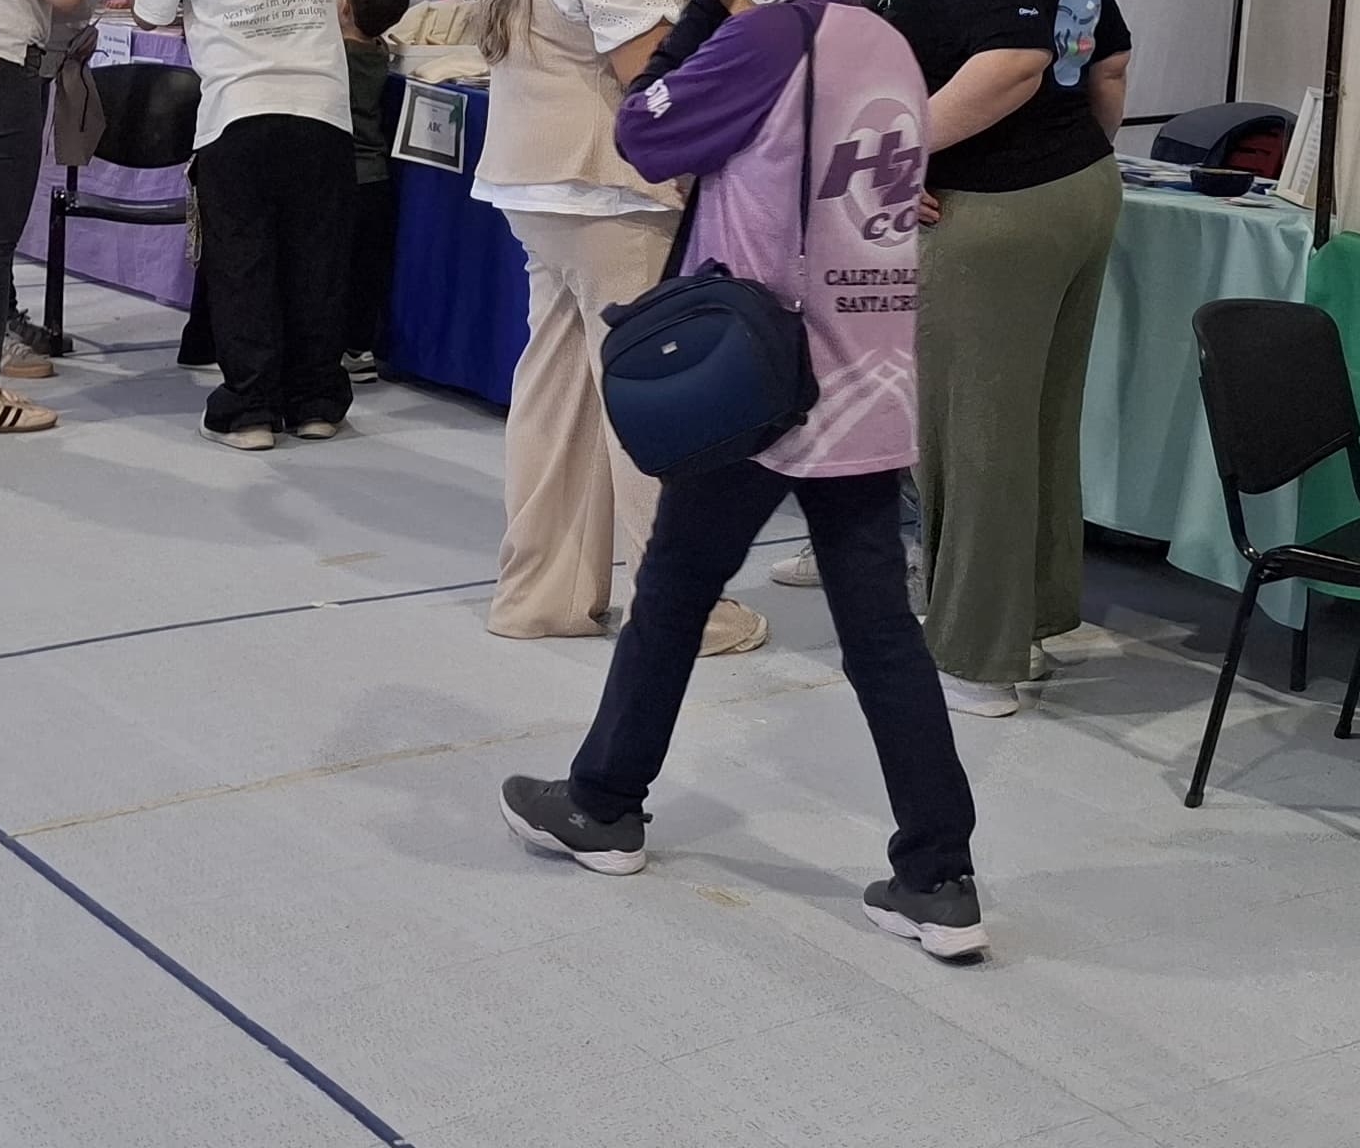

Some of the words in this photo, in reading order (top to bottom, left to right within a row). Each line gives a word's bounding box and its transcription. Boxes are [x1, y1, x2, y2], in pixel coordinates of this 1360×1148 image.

[223, 9, 243, 22] Next
[244, 2, 265, 16] time
[229, 14, 270, 29] someone
[281, 7, 296, 20] my
